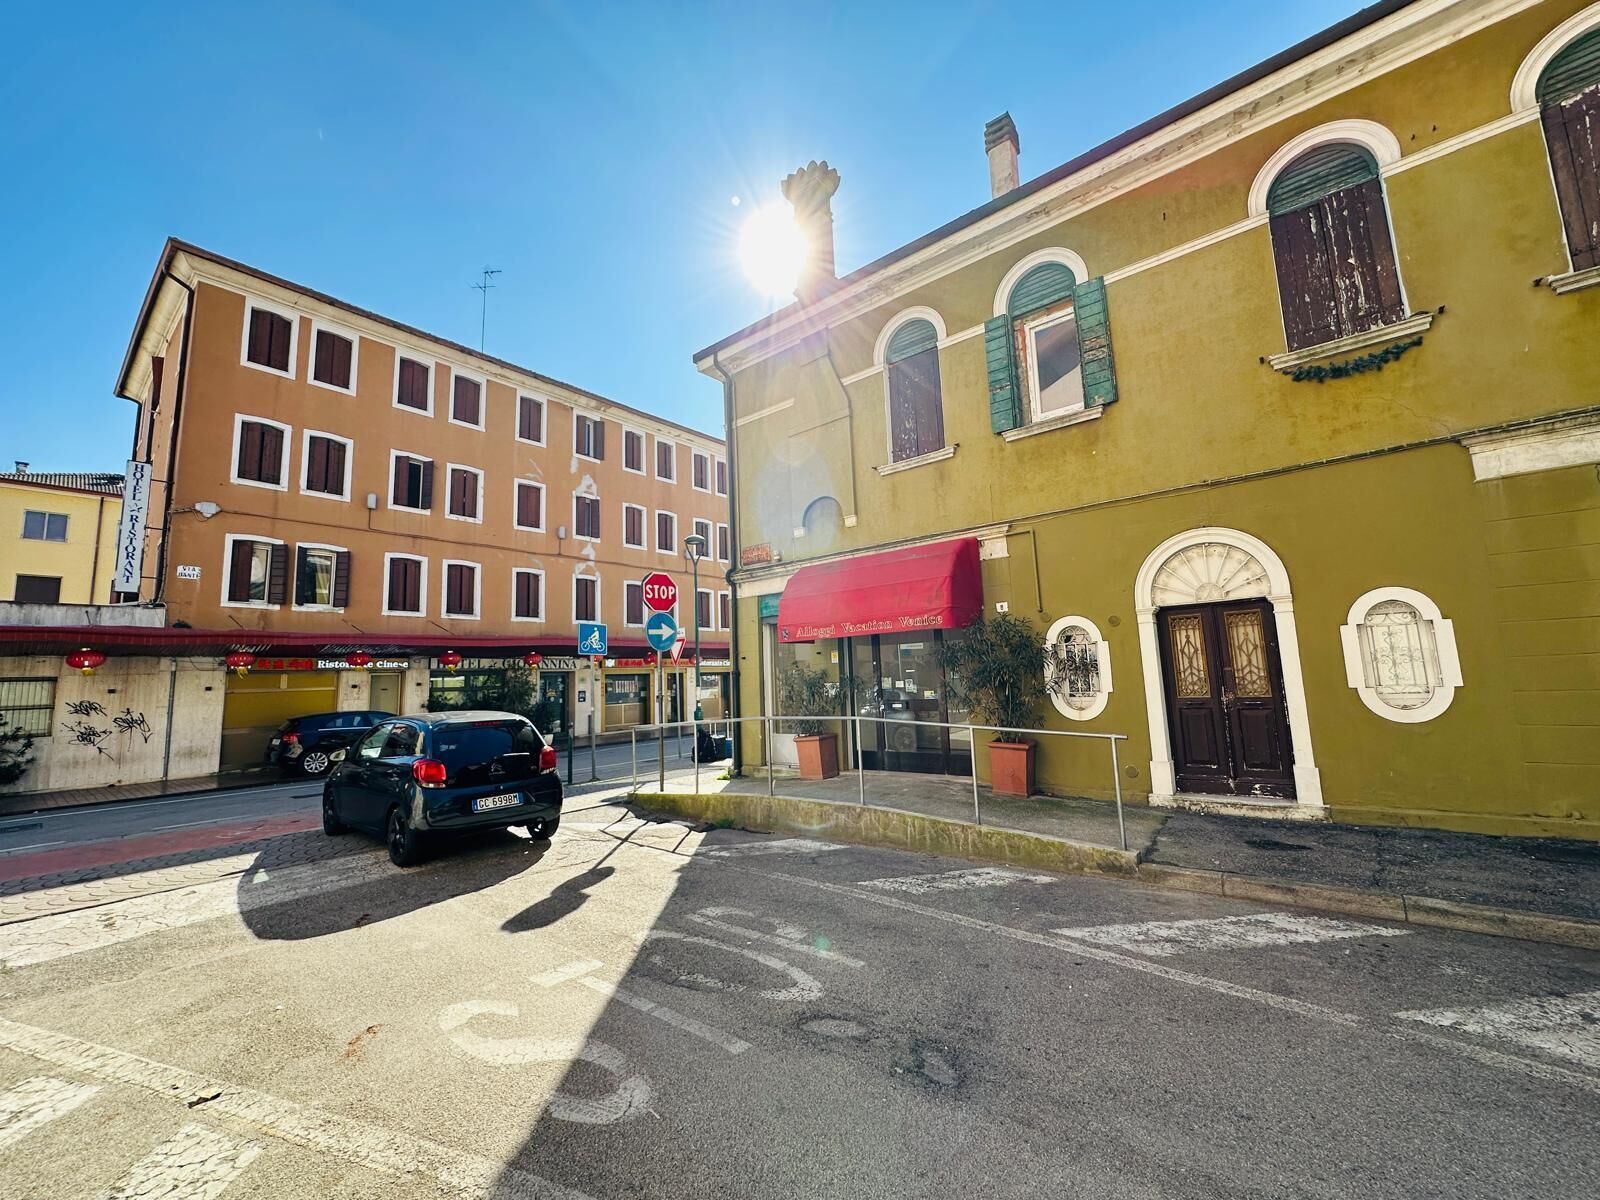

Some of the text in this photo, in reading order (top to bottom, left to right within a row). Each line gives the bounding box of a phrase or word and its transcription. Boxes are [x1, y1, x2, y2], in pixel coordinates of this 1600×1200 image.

[132, 463, 145, 502] HOTEL
[645, 584, 677, 600] STOP
[796, 613, 944, 640] Alloggi Vacation Venice
[428, 658, 482, 669] HTEL
[492, 793, 519, 807] 699BM
[433, 904, 868, 1127] STOP
